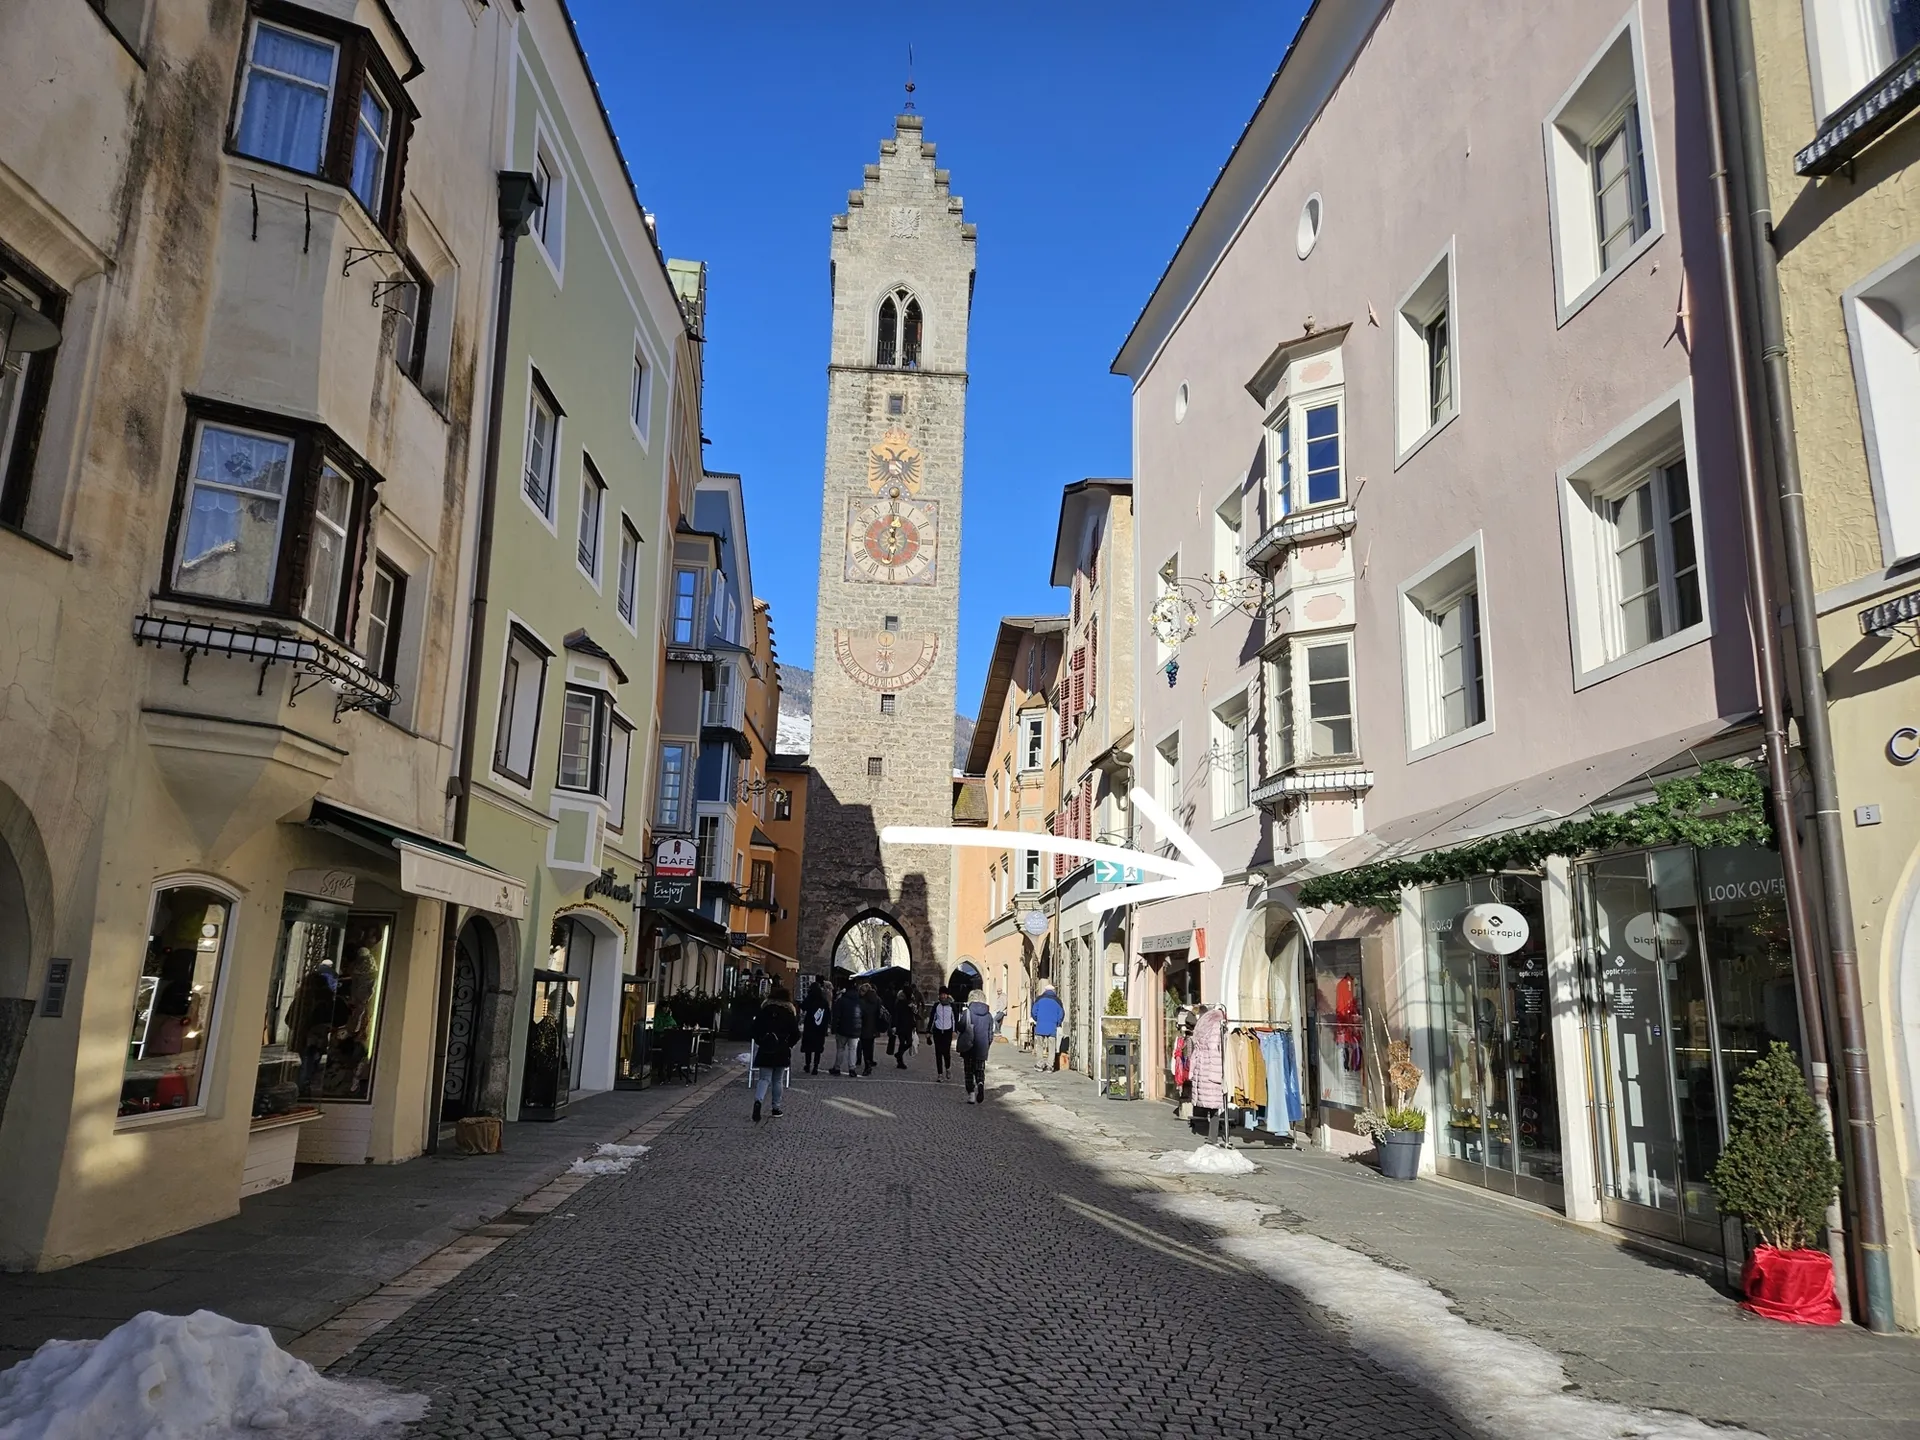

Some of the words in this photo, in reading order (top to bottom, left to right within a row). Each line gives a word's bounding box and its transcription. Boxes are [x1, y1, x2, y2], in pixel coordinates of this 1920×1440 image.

[888, 502, 900, 513] XII
[907, 508, 914, 518] I
[857, 517, 869, 528] X
[918, 521, 929, 530] II
[905, 565, 914, 577] V
[1866, 811, 1871, 820] 5
[659, 855, 694, 866] CAFÈ
[654, 880, 684, 905] Enjoy
[1709, 882, 1747, 902] LOOK
[1470, 928, 1496, 937] optic
[1497, 930, 1522, 939] rapid
[1606, 968, 1620, 977] optic
